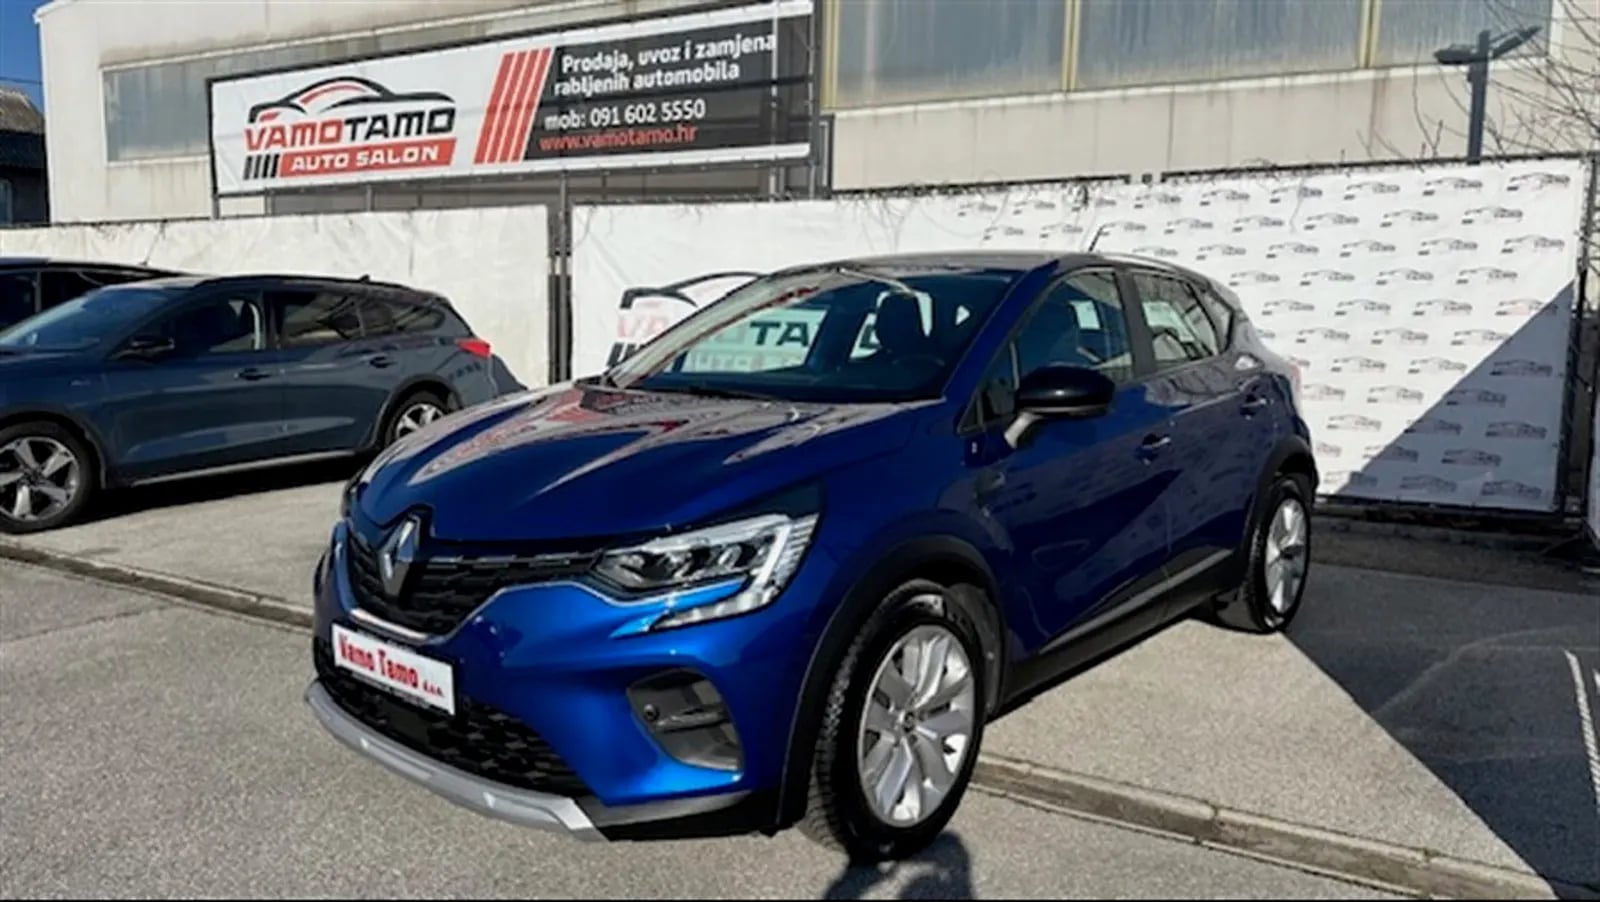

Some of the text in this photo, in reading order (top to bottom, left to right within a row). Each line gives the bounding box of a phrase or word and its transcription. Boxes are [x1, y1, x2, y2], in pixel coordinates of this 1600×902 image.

[563, 33, 776, 74] Prodaja, uvoz i zamjena
[554, 61, 739, 97] rabljenih automobila
[245, 107, 456, 150] VAMOTAMO
[544, 98, 706, 129] mob: 091 602 5550
[540, 124, 697, 150] www.vamotamo.hr
[291, 146, 438, 171] AUTO SALON
[379, 648, 418, 688] Tamo
